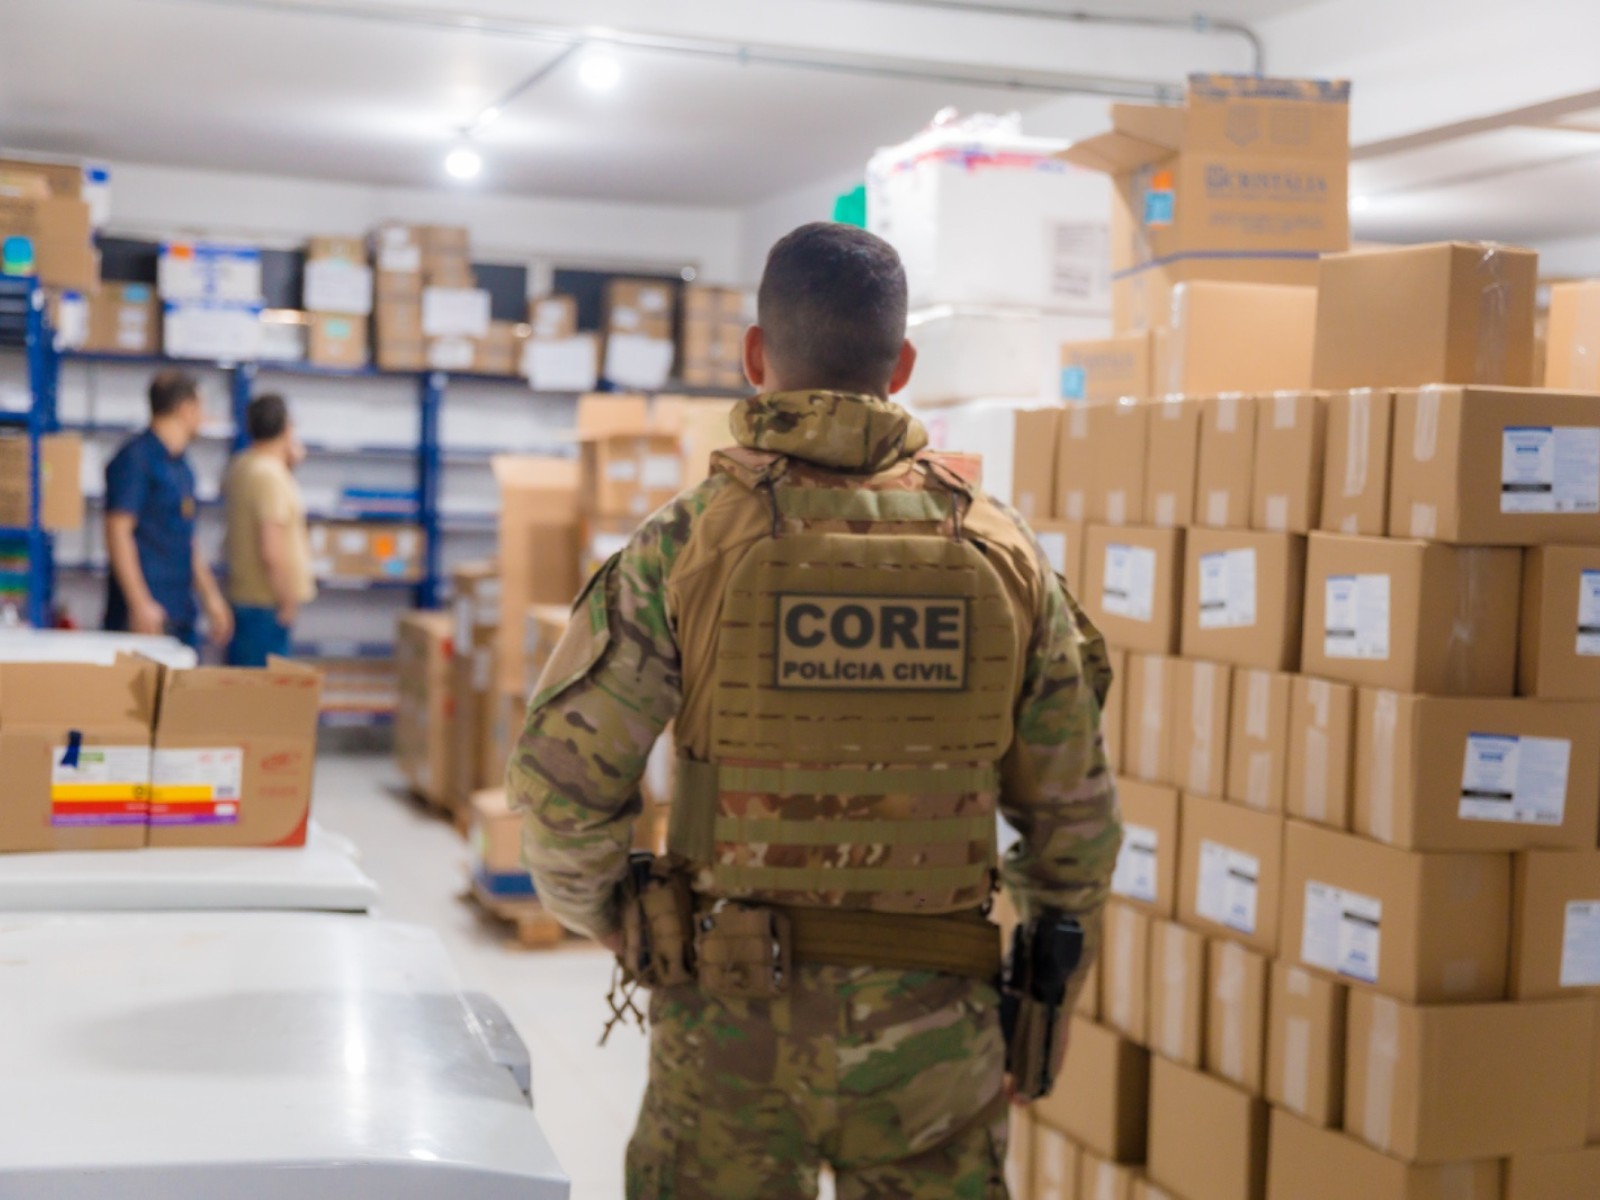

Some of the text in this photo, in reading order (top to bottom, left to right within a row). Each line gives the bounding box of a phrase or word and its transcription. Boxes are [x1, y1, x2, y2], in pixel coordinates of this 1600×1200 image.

[785, 603, 960, 649] CORE
[783, 657, 958, 681] POLÍCIA CIVIL
